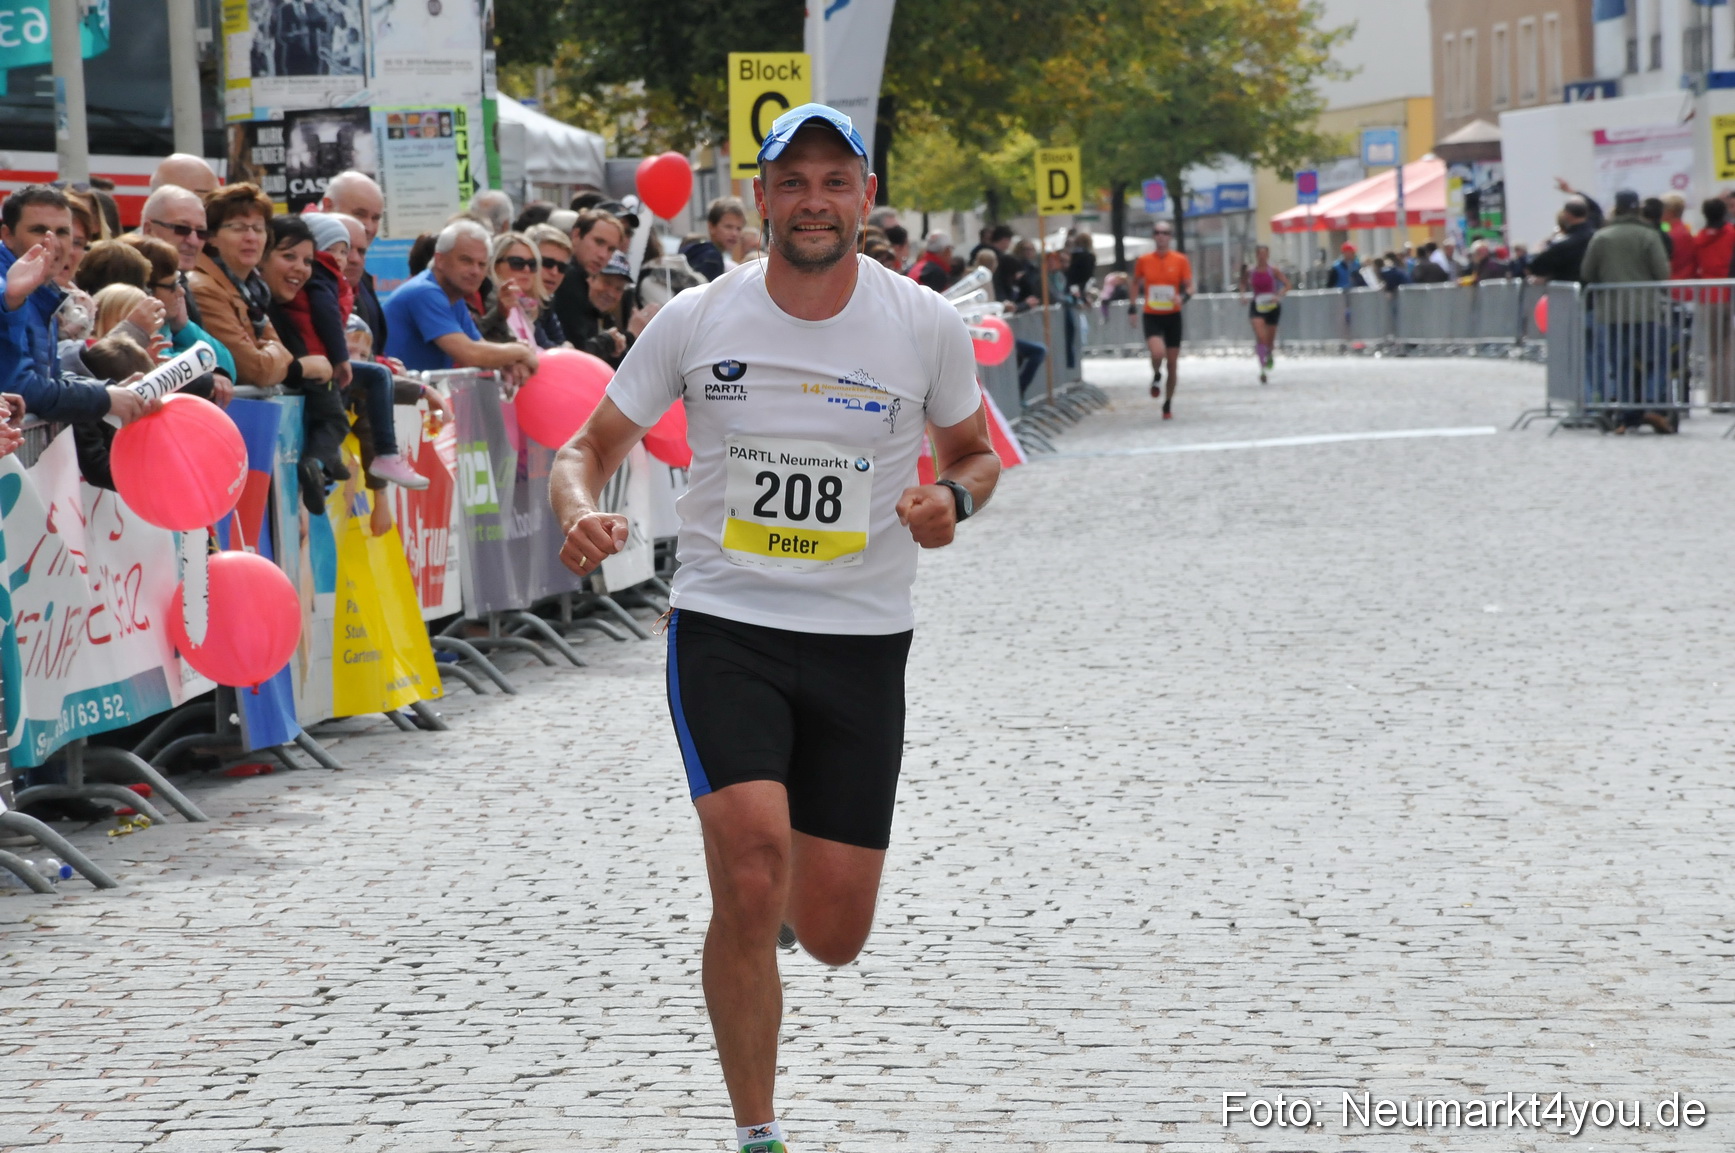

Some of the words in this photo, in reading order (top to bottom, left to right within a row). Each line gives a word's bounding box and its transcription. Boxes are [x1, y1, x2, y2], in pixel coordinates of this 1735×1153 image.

[740, 60, 801, 81] Block
[751, 91, 790, 148] C
[1041, 152, 1073, 164] Block
[1048, 168, 1070, 200] D
[704, 384, 748, 395] PARTL
[705, 393, 747, 402] Neumarkt
[801, 383, 826, 396] 14.
[729, 445, 777, 464] PARTL
[780, 452, 849, 470] Neumarkt
[753, 470, 843, 524] 208
[768, 533, 819, 555] Peter
